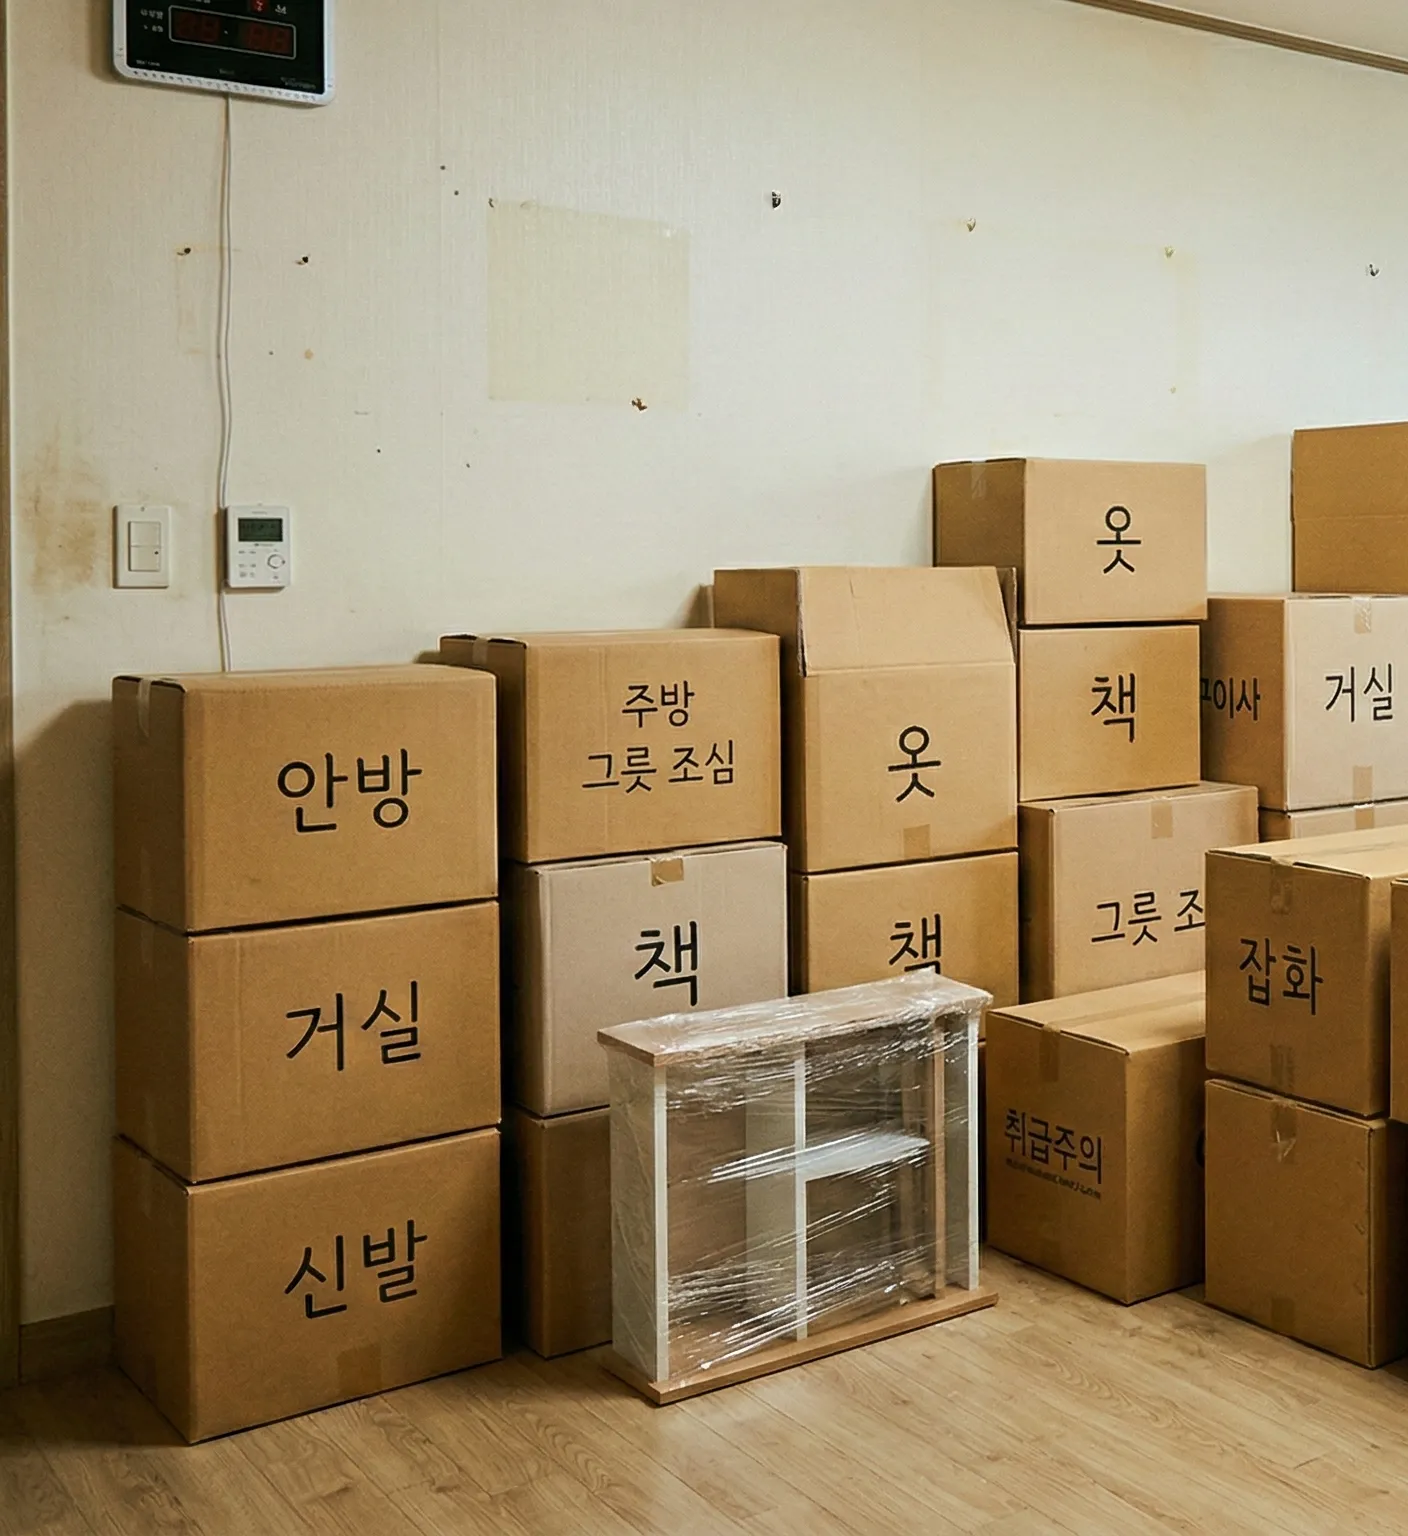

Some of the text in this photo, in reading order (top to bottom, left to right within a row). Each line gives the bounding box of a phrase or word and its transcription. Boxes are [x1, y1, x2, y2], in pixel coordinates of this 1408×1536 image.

[1096, 505, 1142, 574] 옷
[621, 680, 695, 729] 주방
[1090, 672, 1136, 744] 책
[1325, 663, 1394, 723] 거실
[277, 748, 423, 833] 안방
[581, 739, 734, 794] 그릇 조심
[887, 725, 942, 803] 옷
[888, 913, 942, 975] 책
[1091, 891, 1162, 946] 그릇
[634, 920, 698, 1007] 책
[1239, 937, 1324, 1016] 잡화
[285, 980, 422, 1072] 거실
[1004, 1108, 1102, 1185] 취급주의
[284, 1219, 428, 1320] 신발
